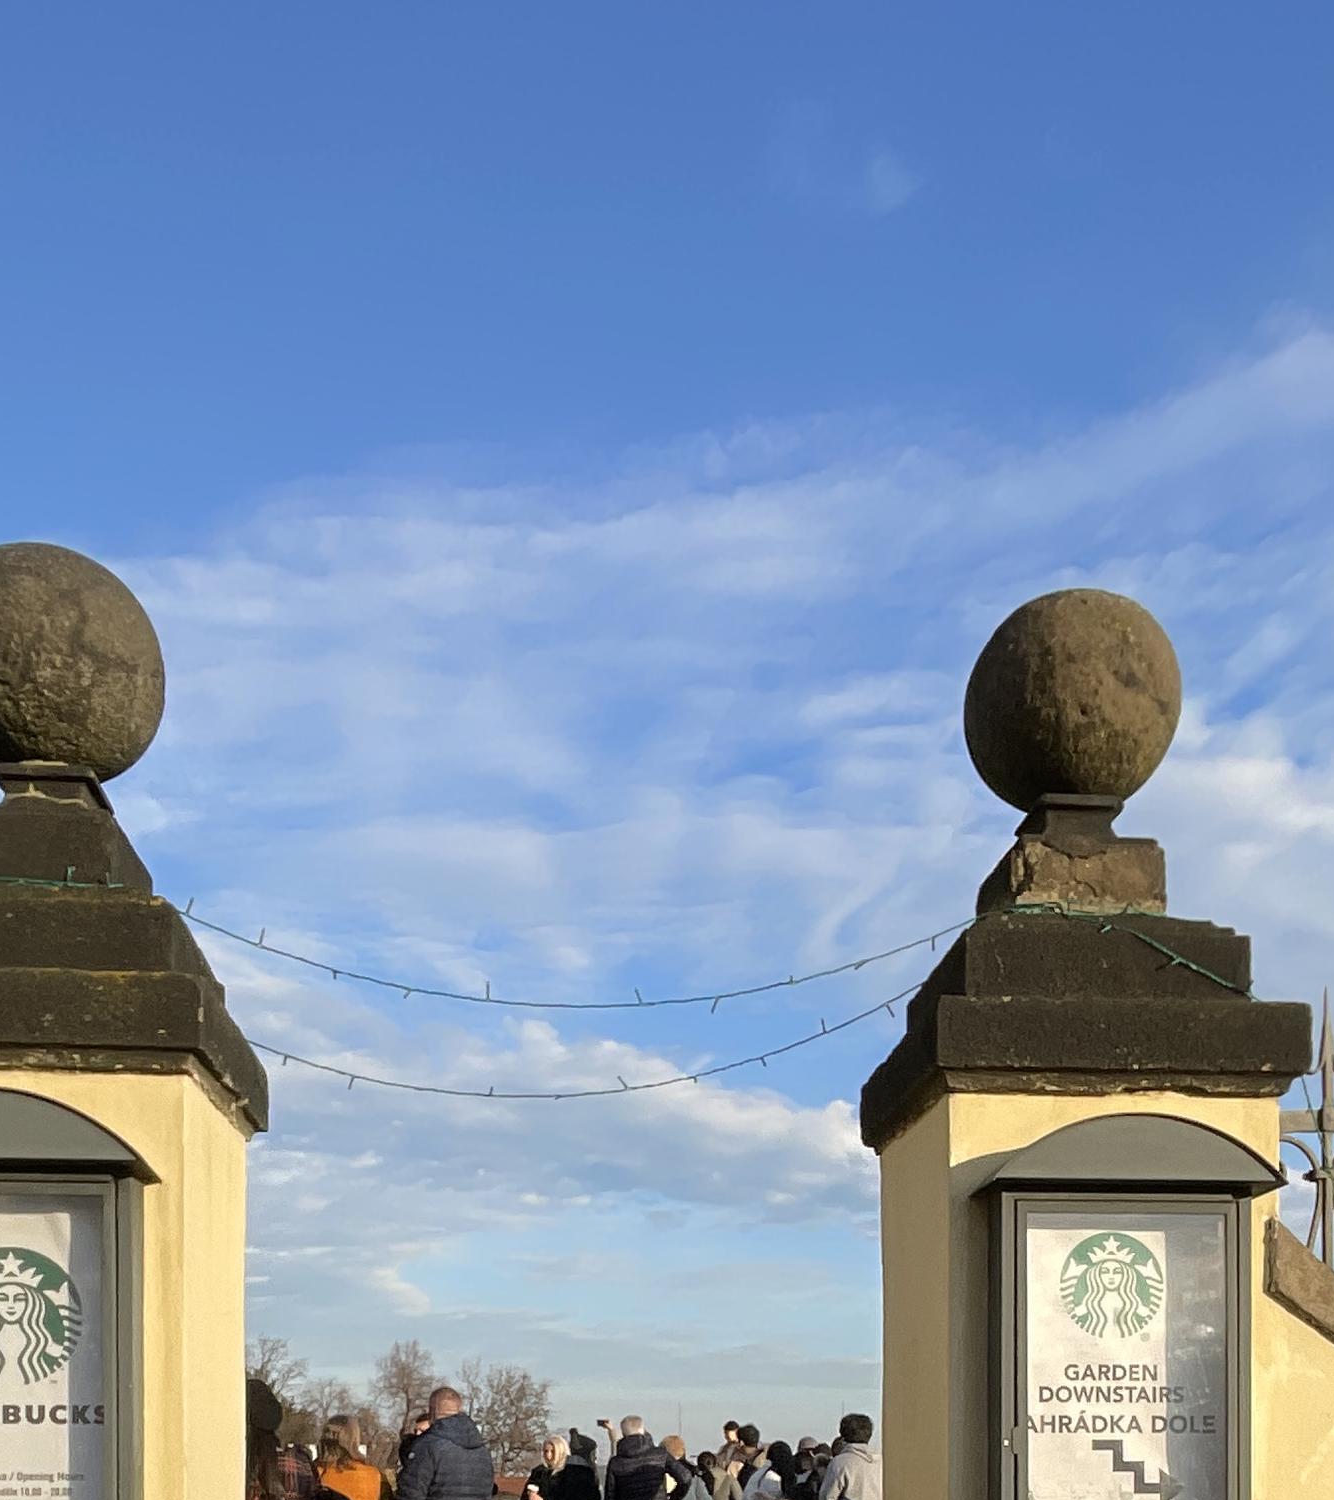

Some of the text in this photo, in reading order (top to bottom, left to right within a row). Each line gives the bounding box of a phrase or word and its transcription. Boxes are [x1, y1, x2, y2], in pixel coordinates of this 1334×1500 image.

[1064, 1364, 1158, 1381] GARDEN
[1039, 1386, 1185, 1403] DOWNSTAIRS
[1027, 1411, 1216, 1434] AHRÁDKA DOLE
